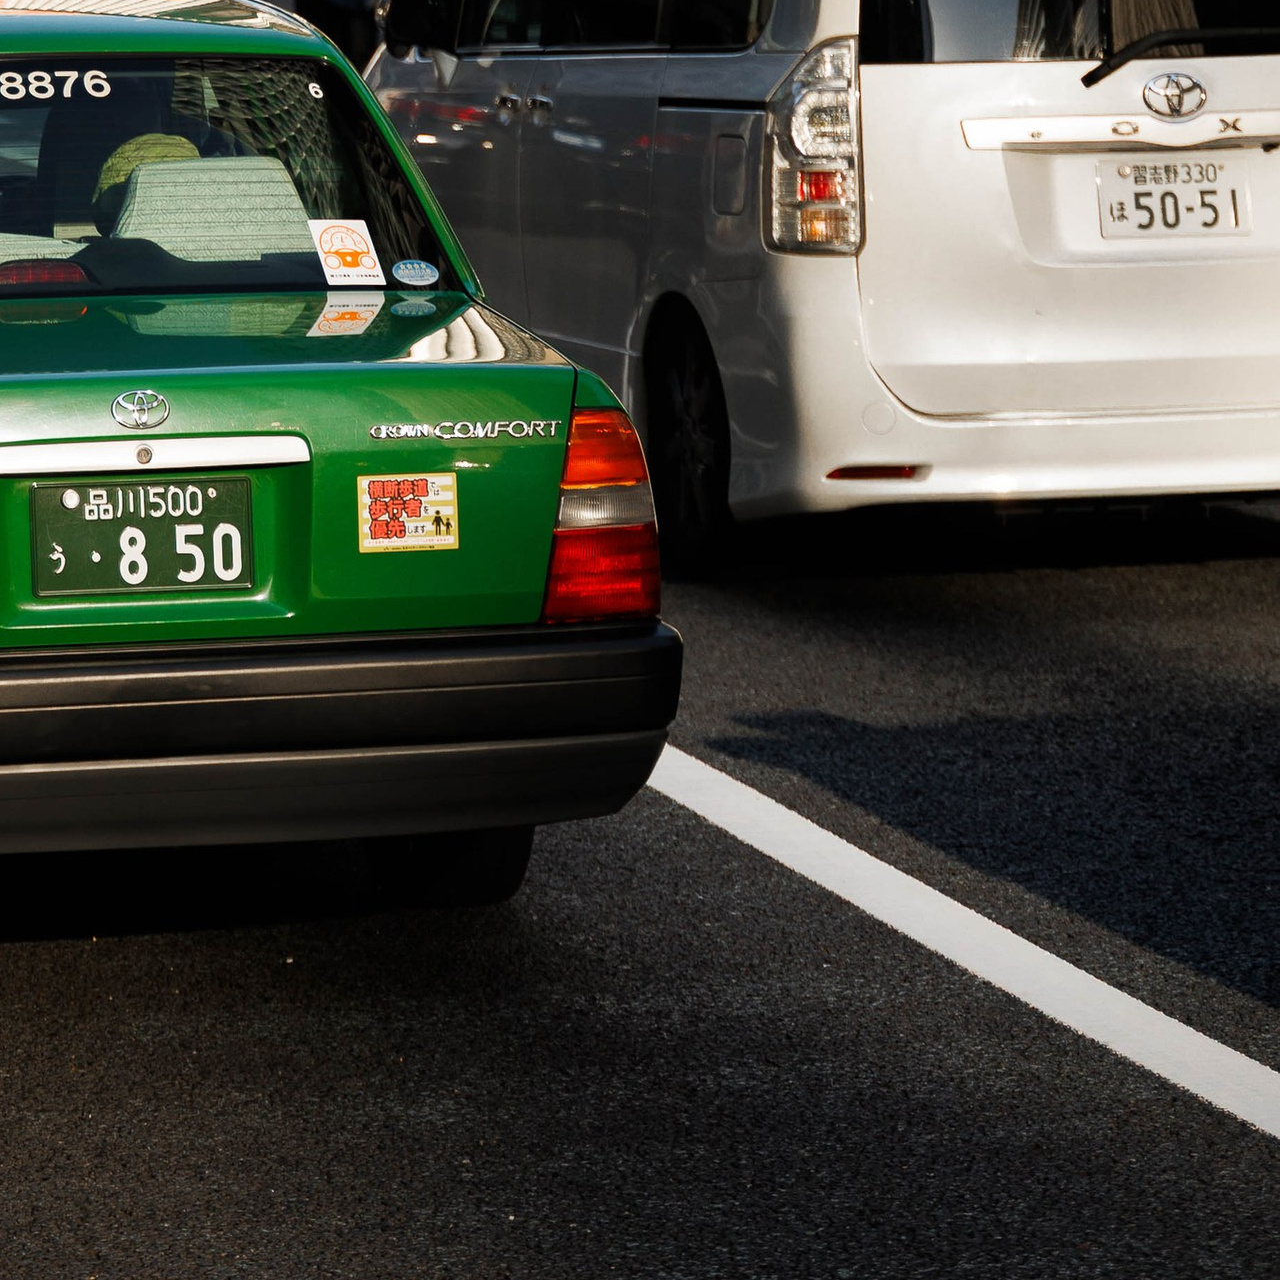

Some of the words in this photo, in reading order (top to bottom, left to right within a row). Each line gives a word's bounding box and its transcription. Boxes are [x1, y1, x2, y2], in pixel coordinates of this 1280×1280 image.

[0, 69, 112, 101] 8876
[308, 82, 325, 99] 6
[1133, 189, 1239, 230] 50-51
[370, 423, 430, 438] CROWN
[433, 420, 562, 439] COMFORT
